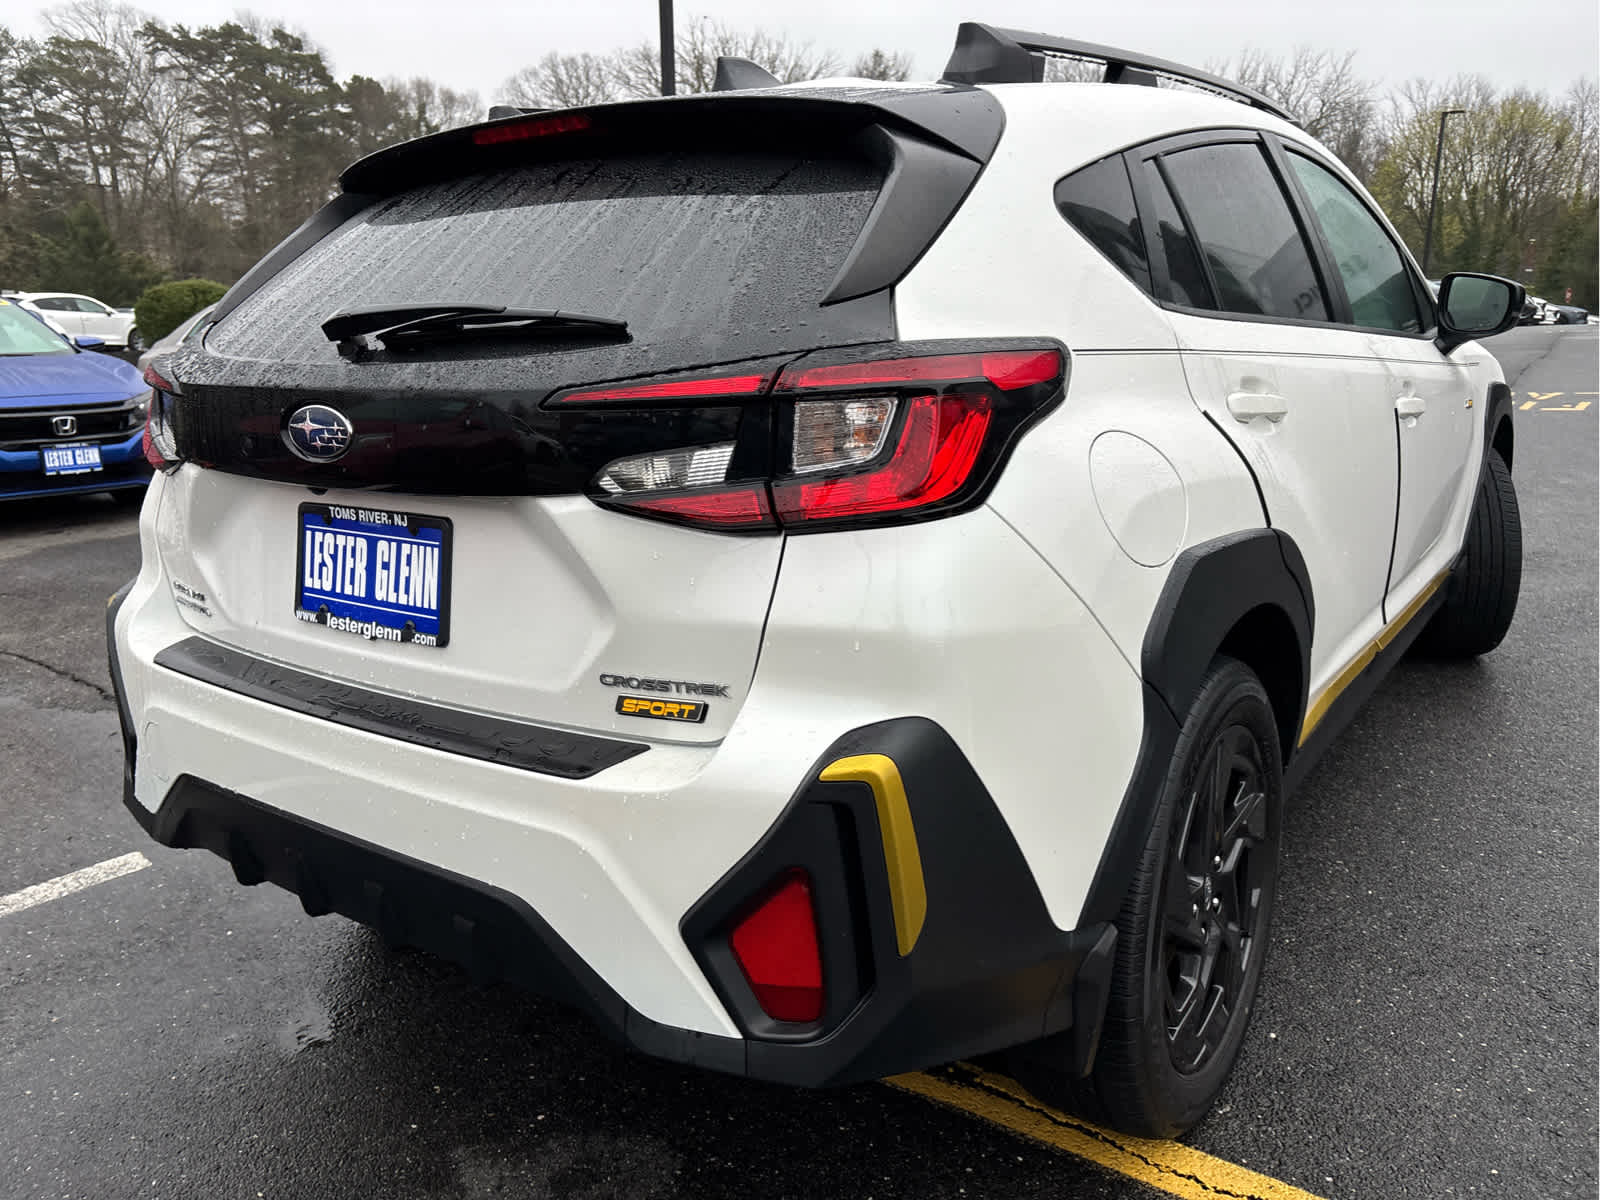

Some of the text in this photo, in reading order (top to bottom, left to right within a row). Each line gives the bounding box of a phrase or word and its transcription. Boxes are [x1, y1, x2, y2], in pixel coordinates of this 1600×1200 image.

[44, 449, 74, 467] LESTER
[329, 506, 356, 520] TOMS
[358, 510, 392, 525] RIVER,
[393, 513, 408, 527] NJ
[304, 530, 439, 610] LESTER GLENN
[296, 609, 437, 647] www. lesterglenn .com
[599, 673, 731, 699] CROSSTREK
[621, 698, 696, 719] SPORT
